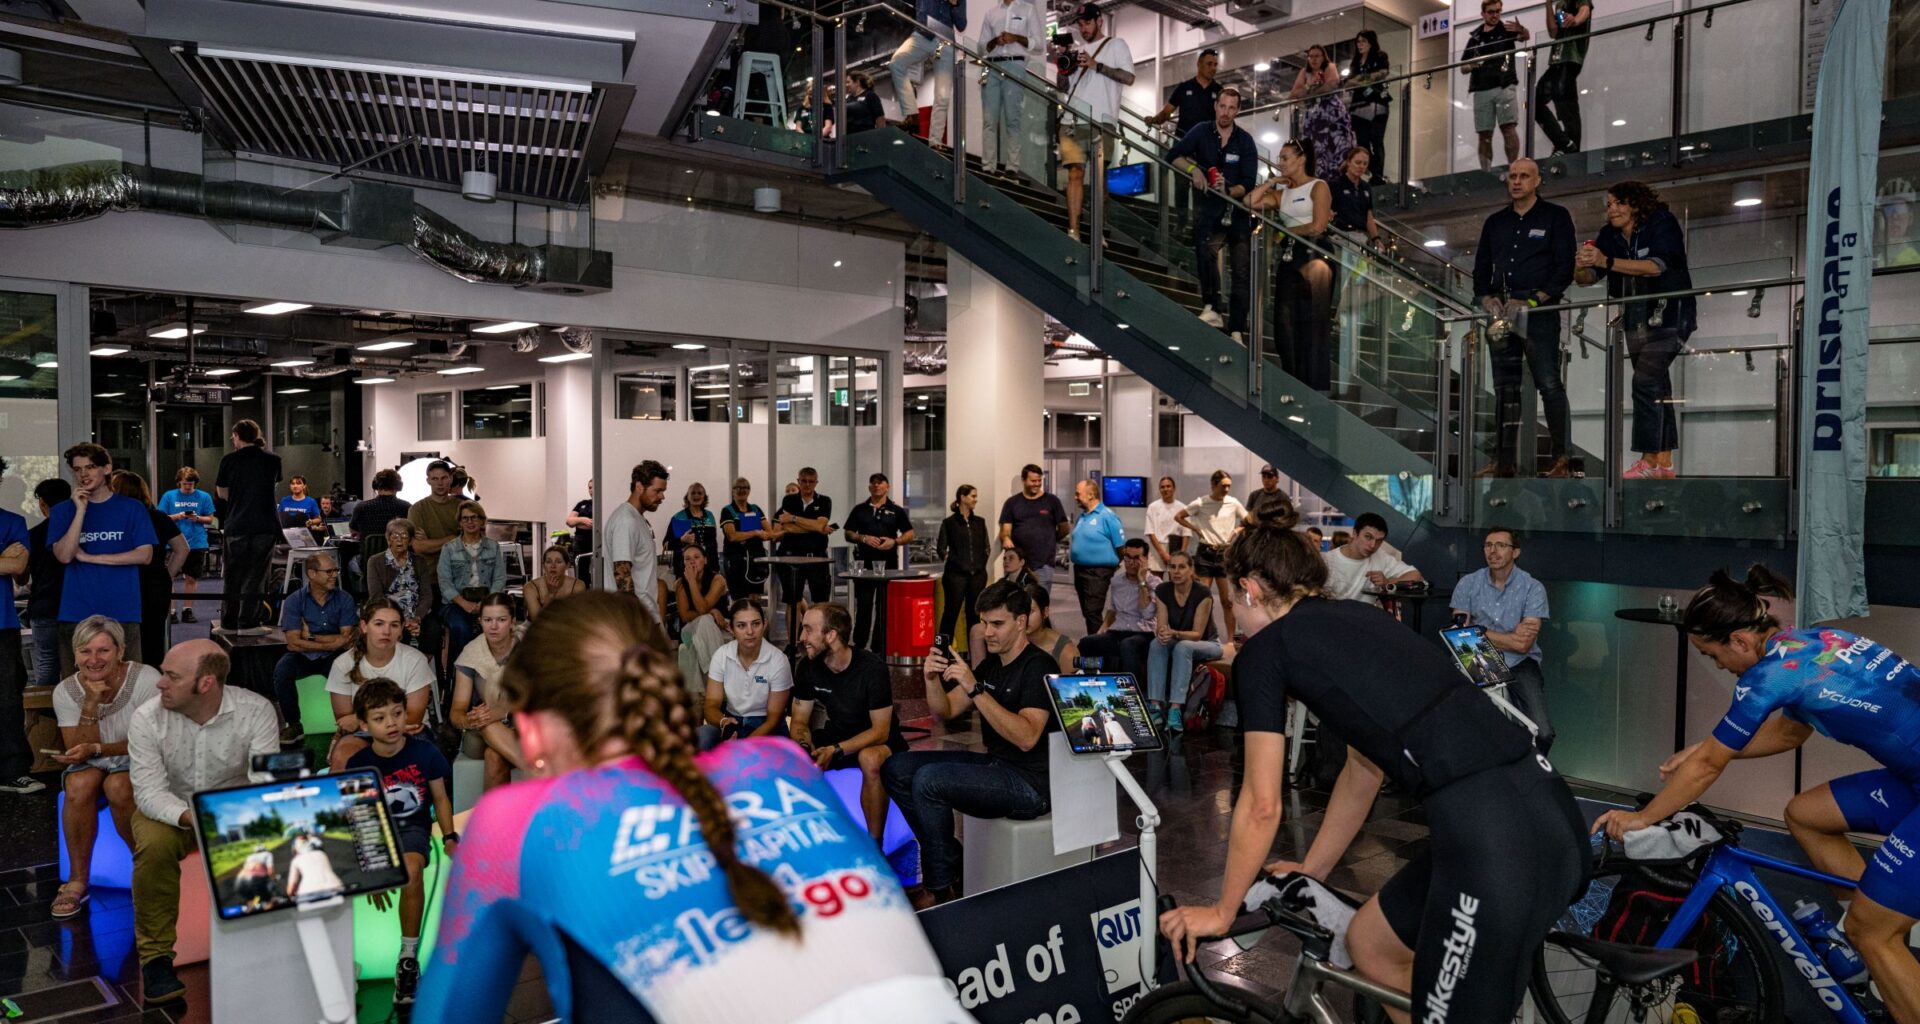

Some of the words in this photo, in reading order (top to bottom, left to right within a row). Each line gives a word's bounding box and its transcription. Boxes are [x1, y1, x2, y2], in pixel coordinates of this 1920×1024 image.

[86, 531, 125, 542] SPORT
[1831, 693, 1882, 715] CUORE
[634, 852, 718, 900] SKIP
[1098, 906, 1141, 949] QUT
[1025, 924, 1066, 983] of
[1422, 891, 1480, 1024] bikestyle
